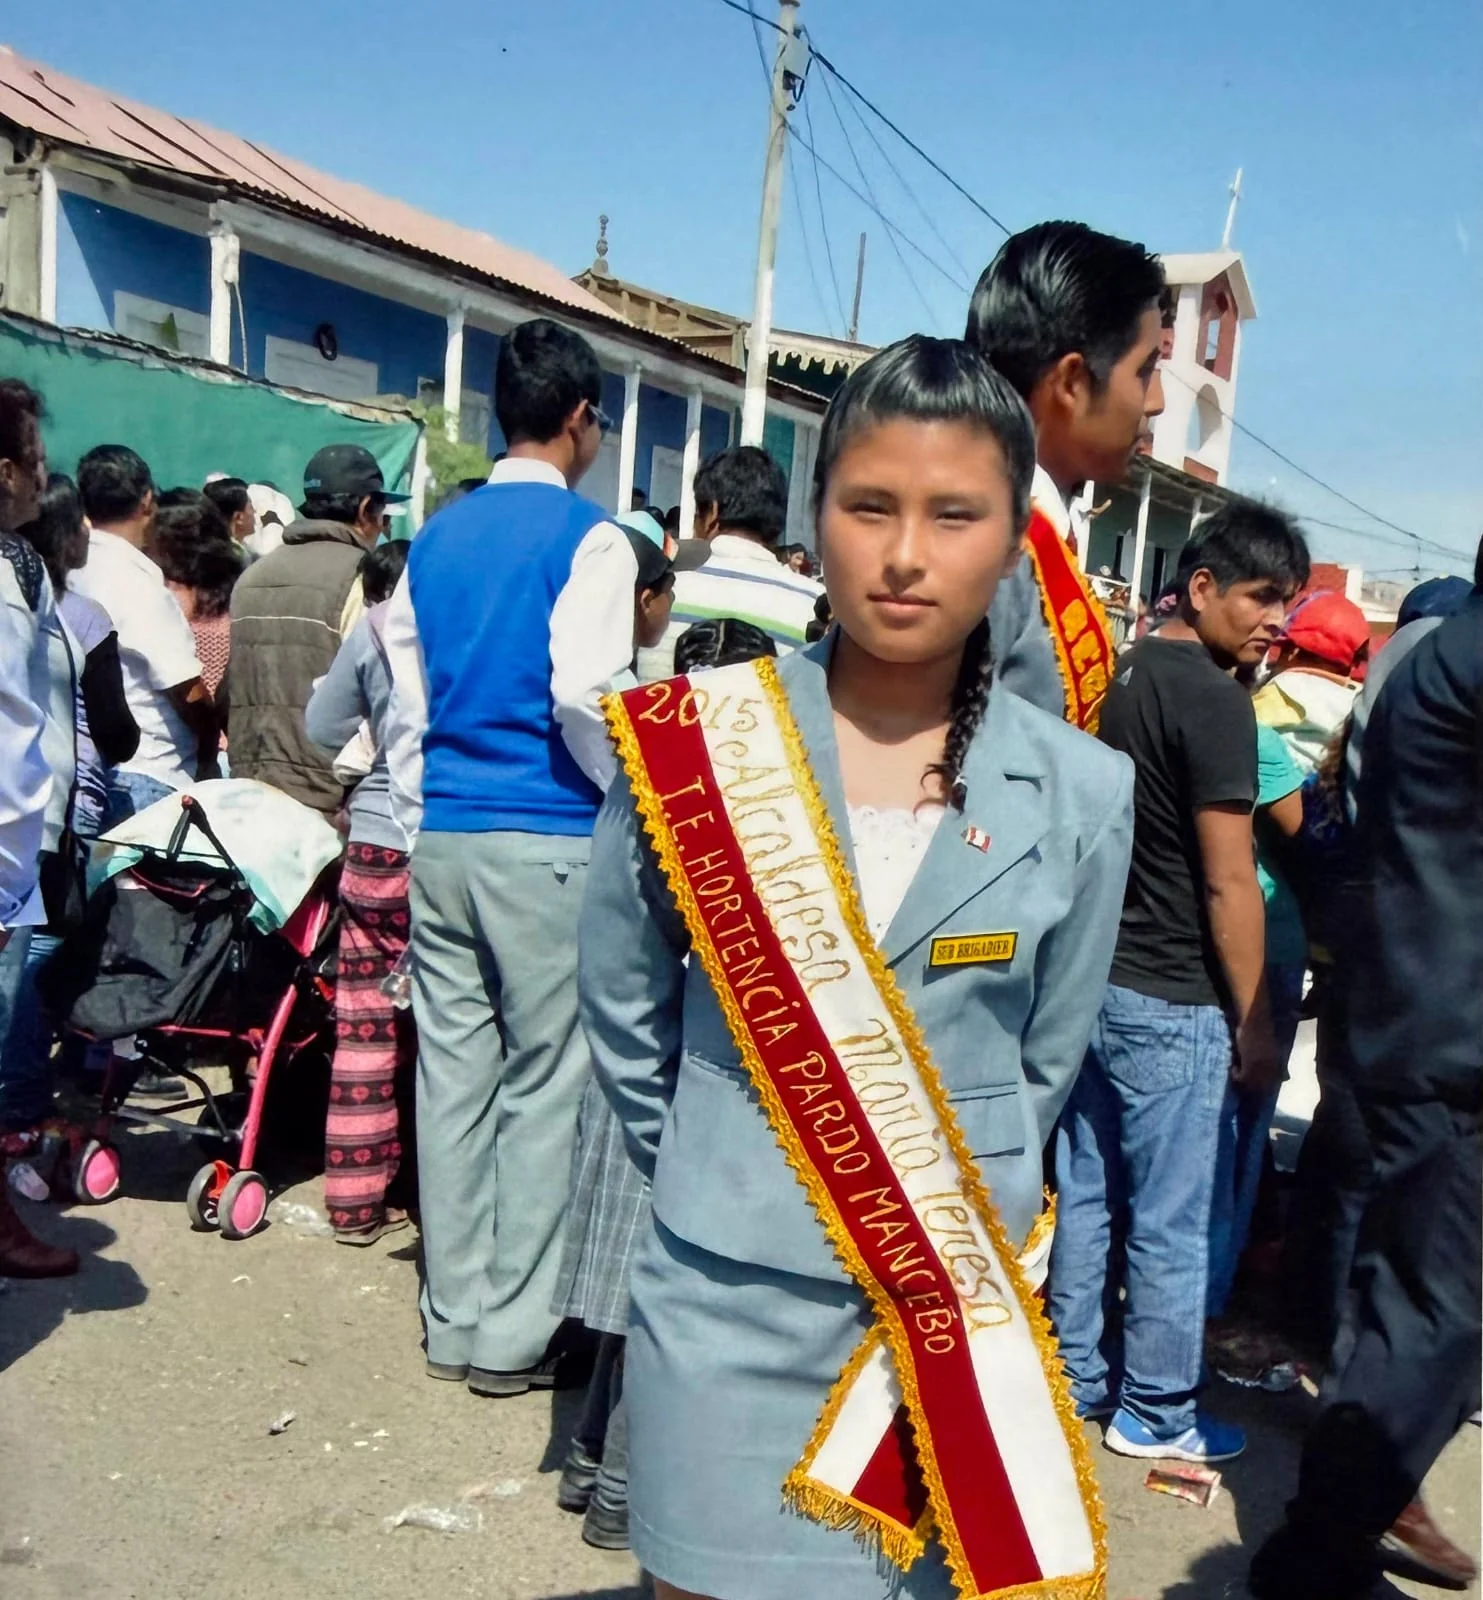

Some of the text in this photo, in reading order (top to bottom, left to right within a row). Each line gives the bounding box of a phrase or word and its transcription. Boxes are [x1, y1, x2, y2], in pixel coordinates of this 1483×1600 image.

[638, 682, 763, 733] 2015
[779, 1050, 872, 1175] PARDO
[848, 1186, 958, 1355] MANCEBO
[913, 1180, 1013, 1338] Teresa
